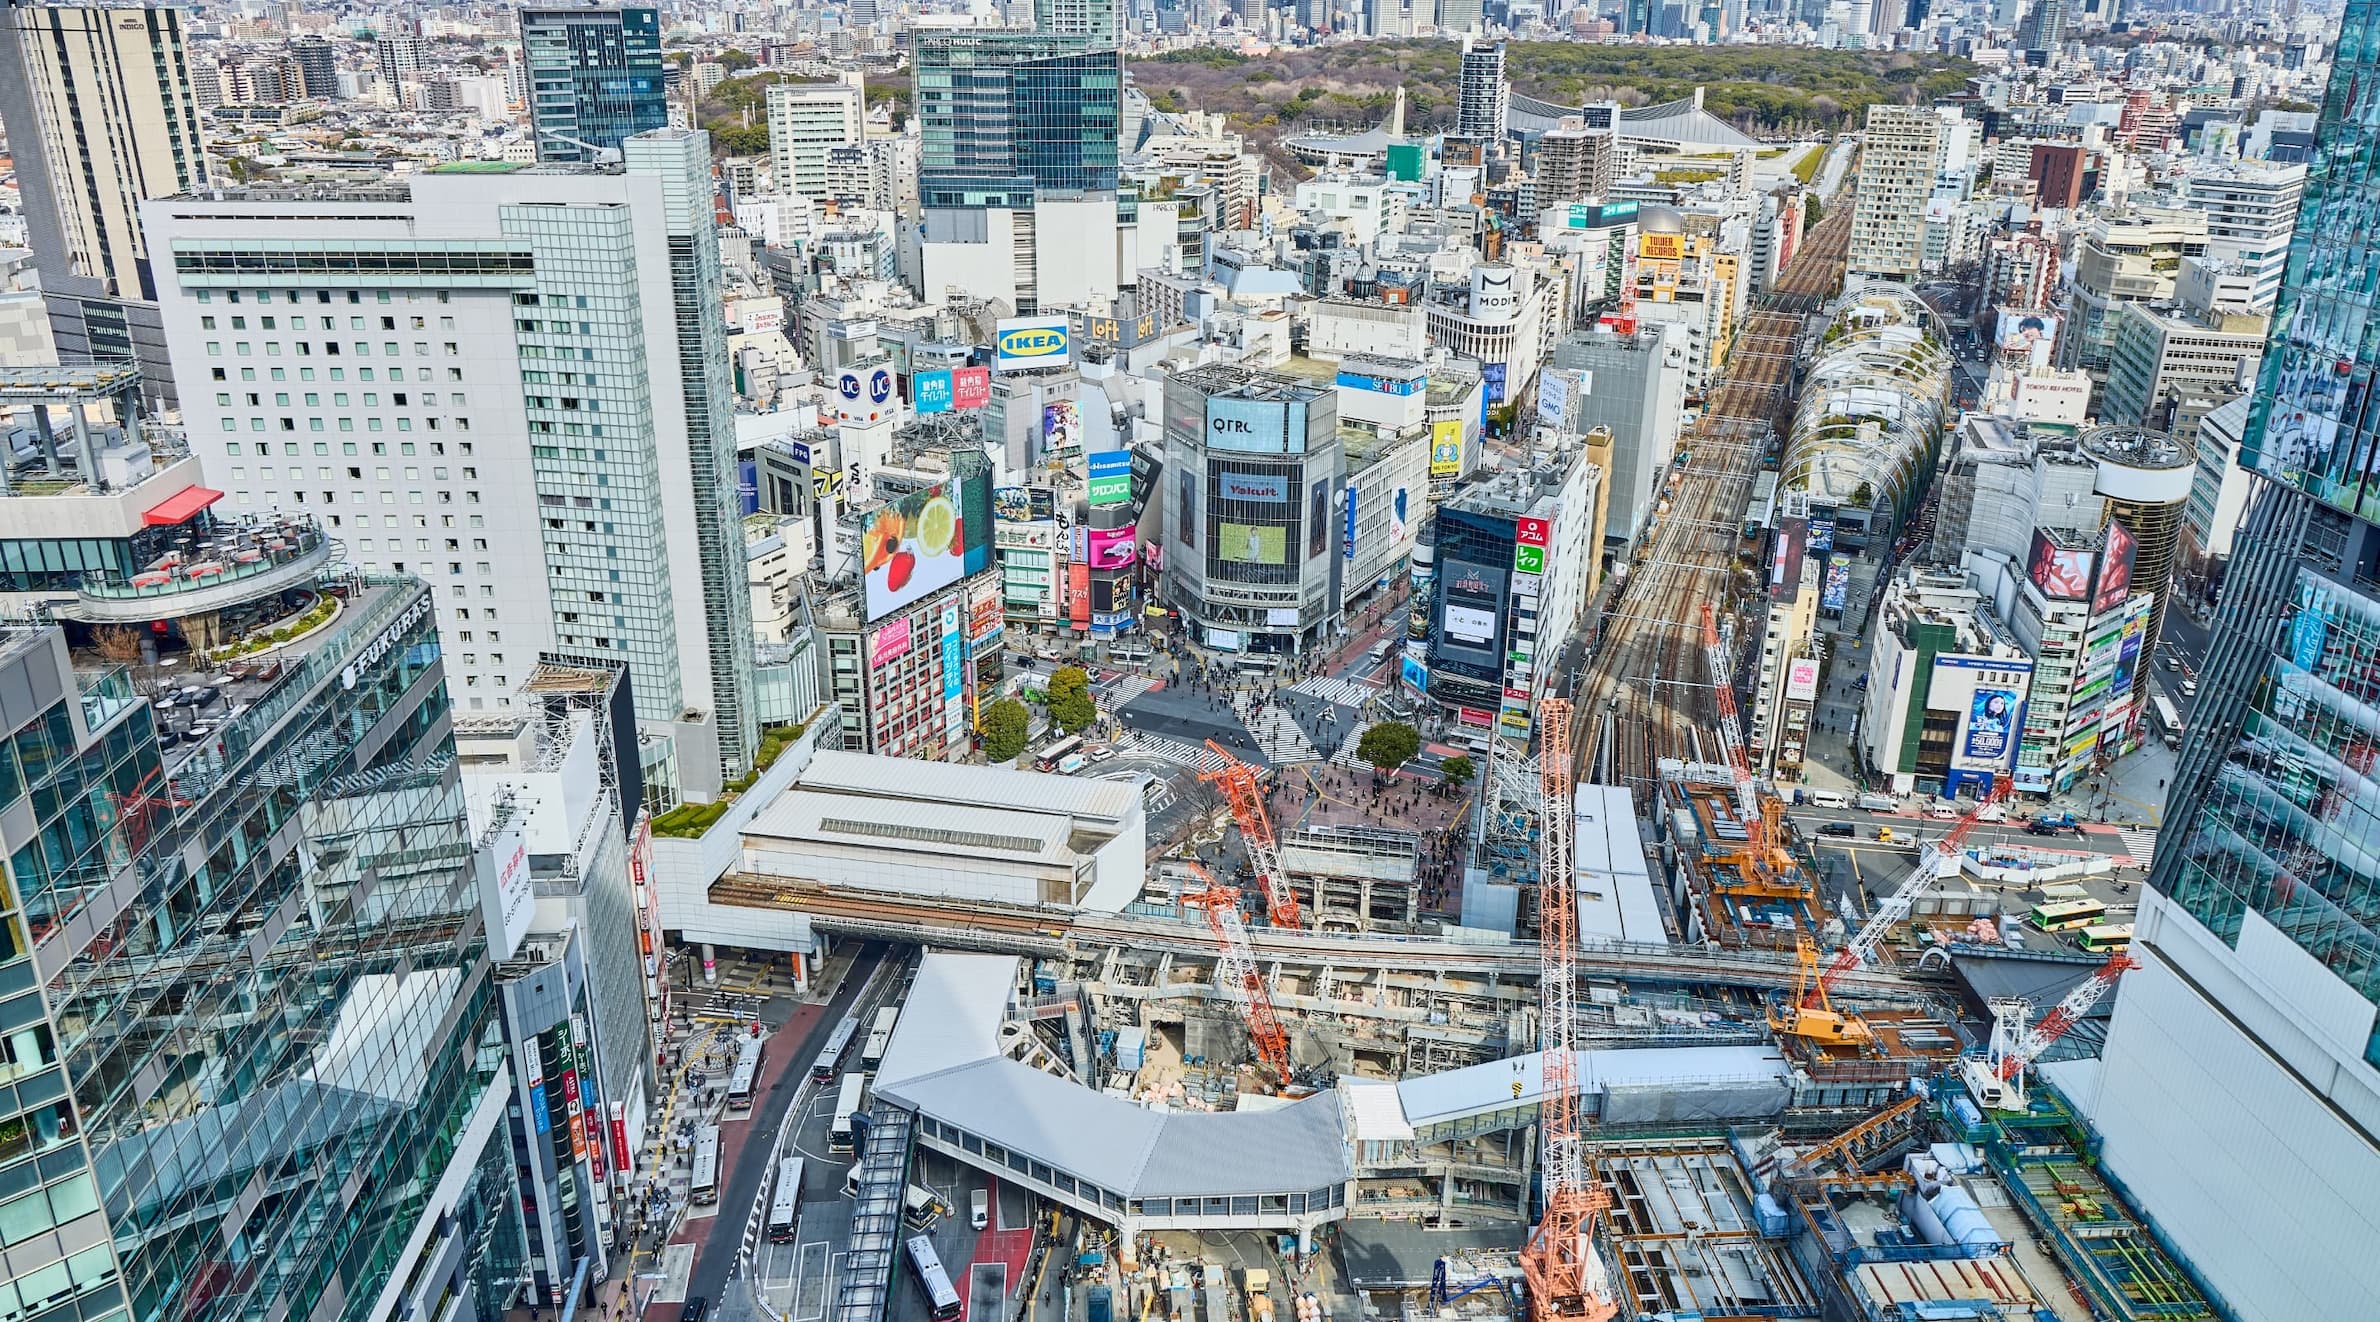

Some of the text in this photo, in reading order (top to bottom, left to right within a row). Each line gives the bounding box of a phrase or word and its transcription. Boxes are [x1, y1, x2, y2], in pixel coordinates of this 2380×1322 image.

[1649, 236, 1673, 247] TOWER
[1645, 246, 1678, 257] RECORDS
[1480, 297, 1511, 307] MODI
[1006, 335, 1062, 350] IKEA
[840, 380, 860, 394] UC
[871, 375, 890, 397] UC
[1541, 398, 1560, 416] GMO
[1055, 511, 1070, 552] もんじゃ
[1520, 530, 1544, 542] アコム
[352, 593, 432, 676] FUKURAS
